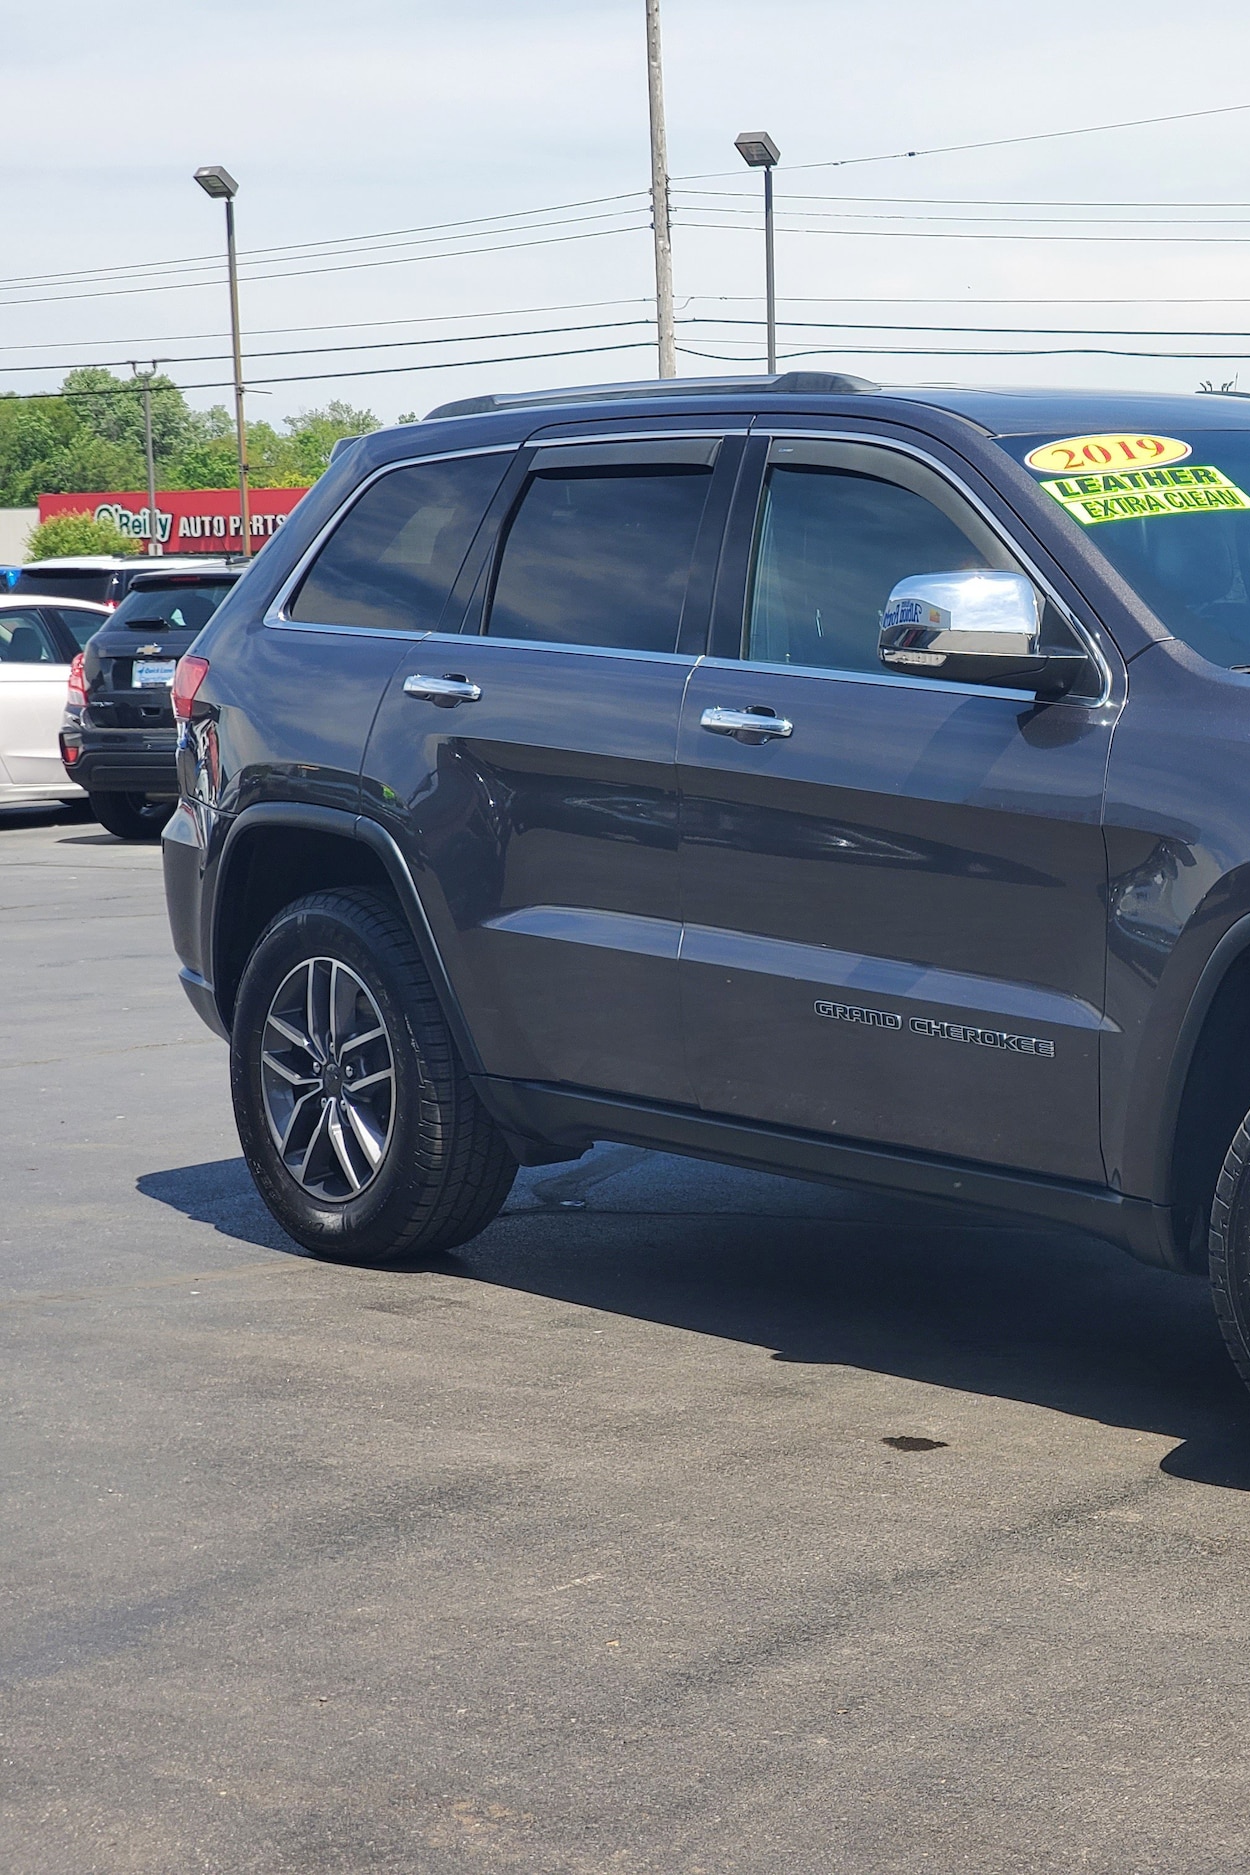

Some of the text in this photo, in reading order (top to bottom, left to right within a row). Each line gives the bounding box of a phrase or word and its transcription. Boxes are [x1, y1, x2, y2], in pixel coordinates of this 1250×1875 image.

[1051, 437, 1166, 470] 2019
[1054, 467, 1223, 499] LEATHER
[1080, 489, 1245, 521] EXTRA CLEAN
[178, 515, 226, 538] AUTO
[813, 999, 1055, 1058] GRAND CHEROKEE
